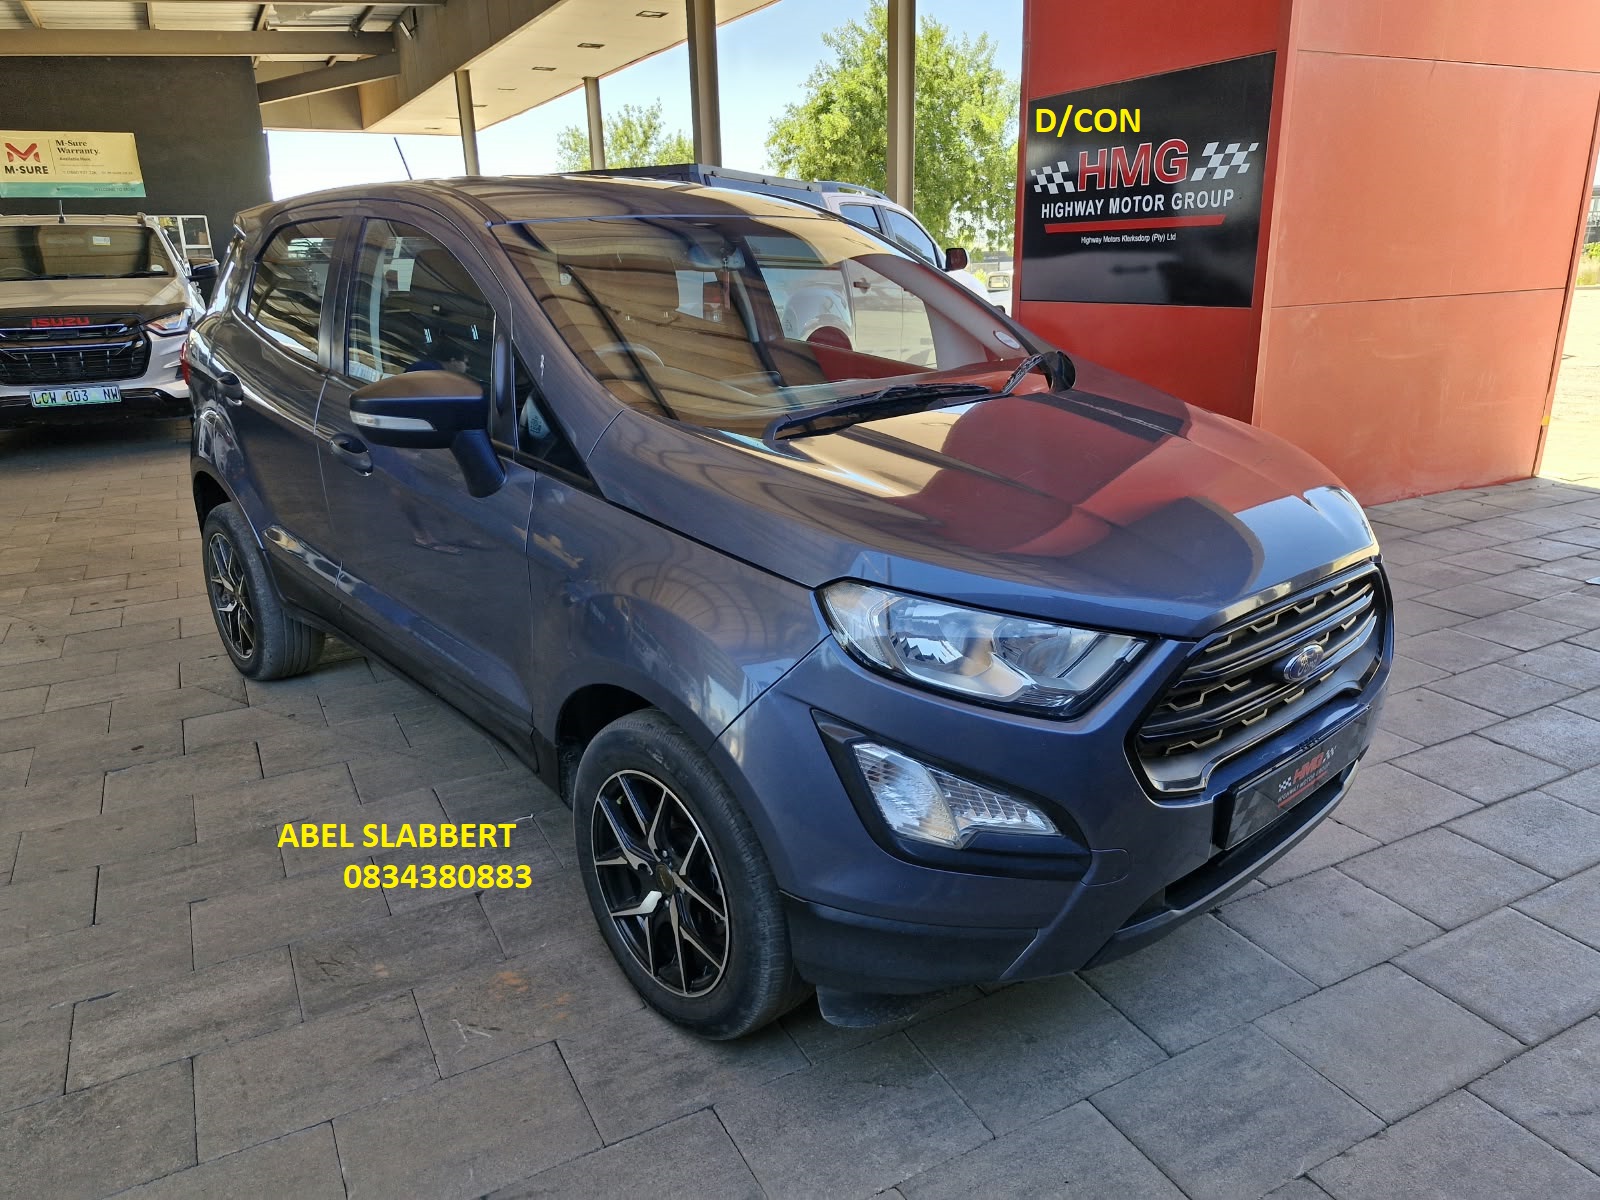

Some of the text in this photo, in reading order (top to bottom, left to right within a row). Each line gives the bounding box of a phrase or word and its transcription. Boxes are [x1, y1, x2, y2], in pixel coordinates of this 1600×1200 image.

[55, 139, 88, 147] M-Sure
[1077, 138, 1188, 192] HMG
[1041, 188, 1235, 219] HIGHWAY MOTOR GROUP
[1080, 236, 1102, 245] Highway
[1103, 235, 1121, 243] Motors
[32, 317, 89, 327] ISUZU
[33, 392, 57, 405] LCW
[103, 387, 119, 401] NW
